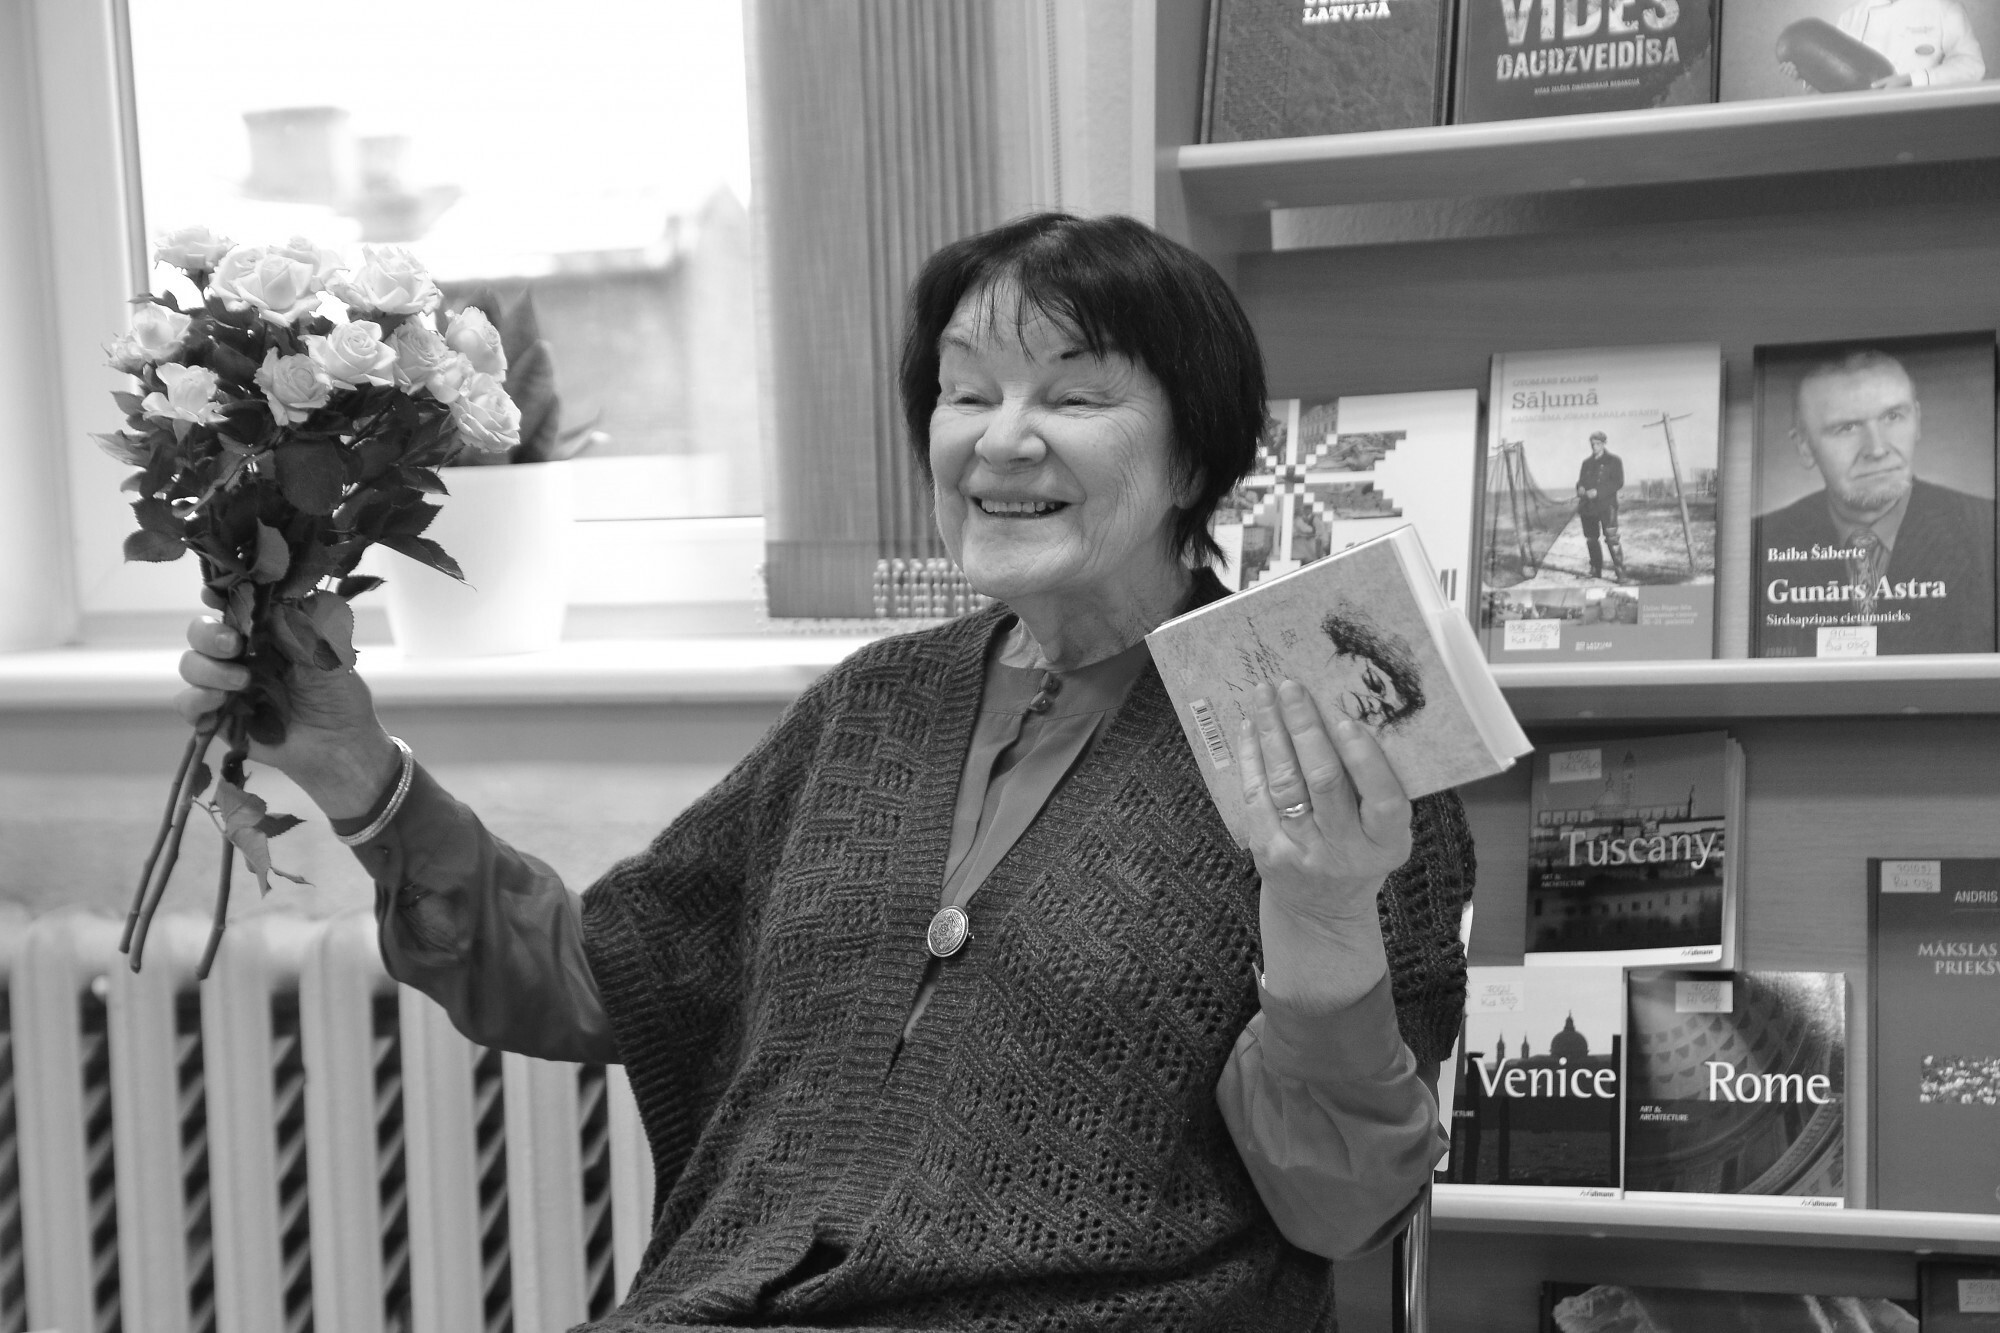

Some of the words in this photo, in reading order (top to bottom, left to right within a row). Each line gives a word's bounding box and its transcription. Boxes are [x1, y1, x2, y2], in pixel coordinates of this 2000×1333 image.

[1302, 1, 1391, 25] LATVIJA
[1497, 35, 1680, 81] DAUDZVEIDĪBA
[1512, 388, 1599, 412] Sāļumā
[1768, 547, 1808, 562] Baiba
[1811, 544, 1866, 561] Šāberte
[1767, 578, 1867, 604] Gunārs
[1873, 575, 1947, 599] Astra
[1766, 612, 1839, 628] Sirdsapziņas
[1840, 610, 1911, 624] cietumnieks
[1560, 830, 1716, 869] Tuscany
[1955, 890, 1998, 903] ANDRIS
[1918, 939, 1998, 957] MĀKSLAS
[1473, 1056, 1617, 1099] Venice
[1704, 1060, 1833, 1104] Rome
[1640, 1105, 1653, 1113] ART
[1640, 1113, 1689, 1121] ARCHITECTURE
